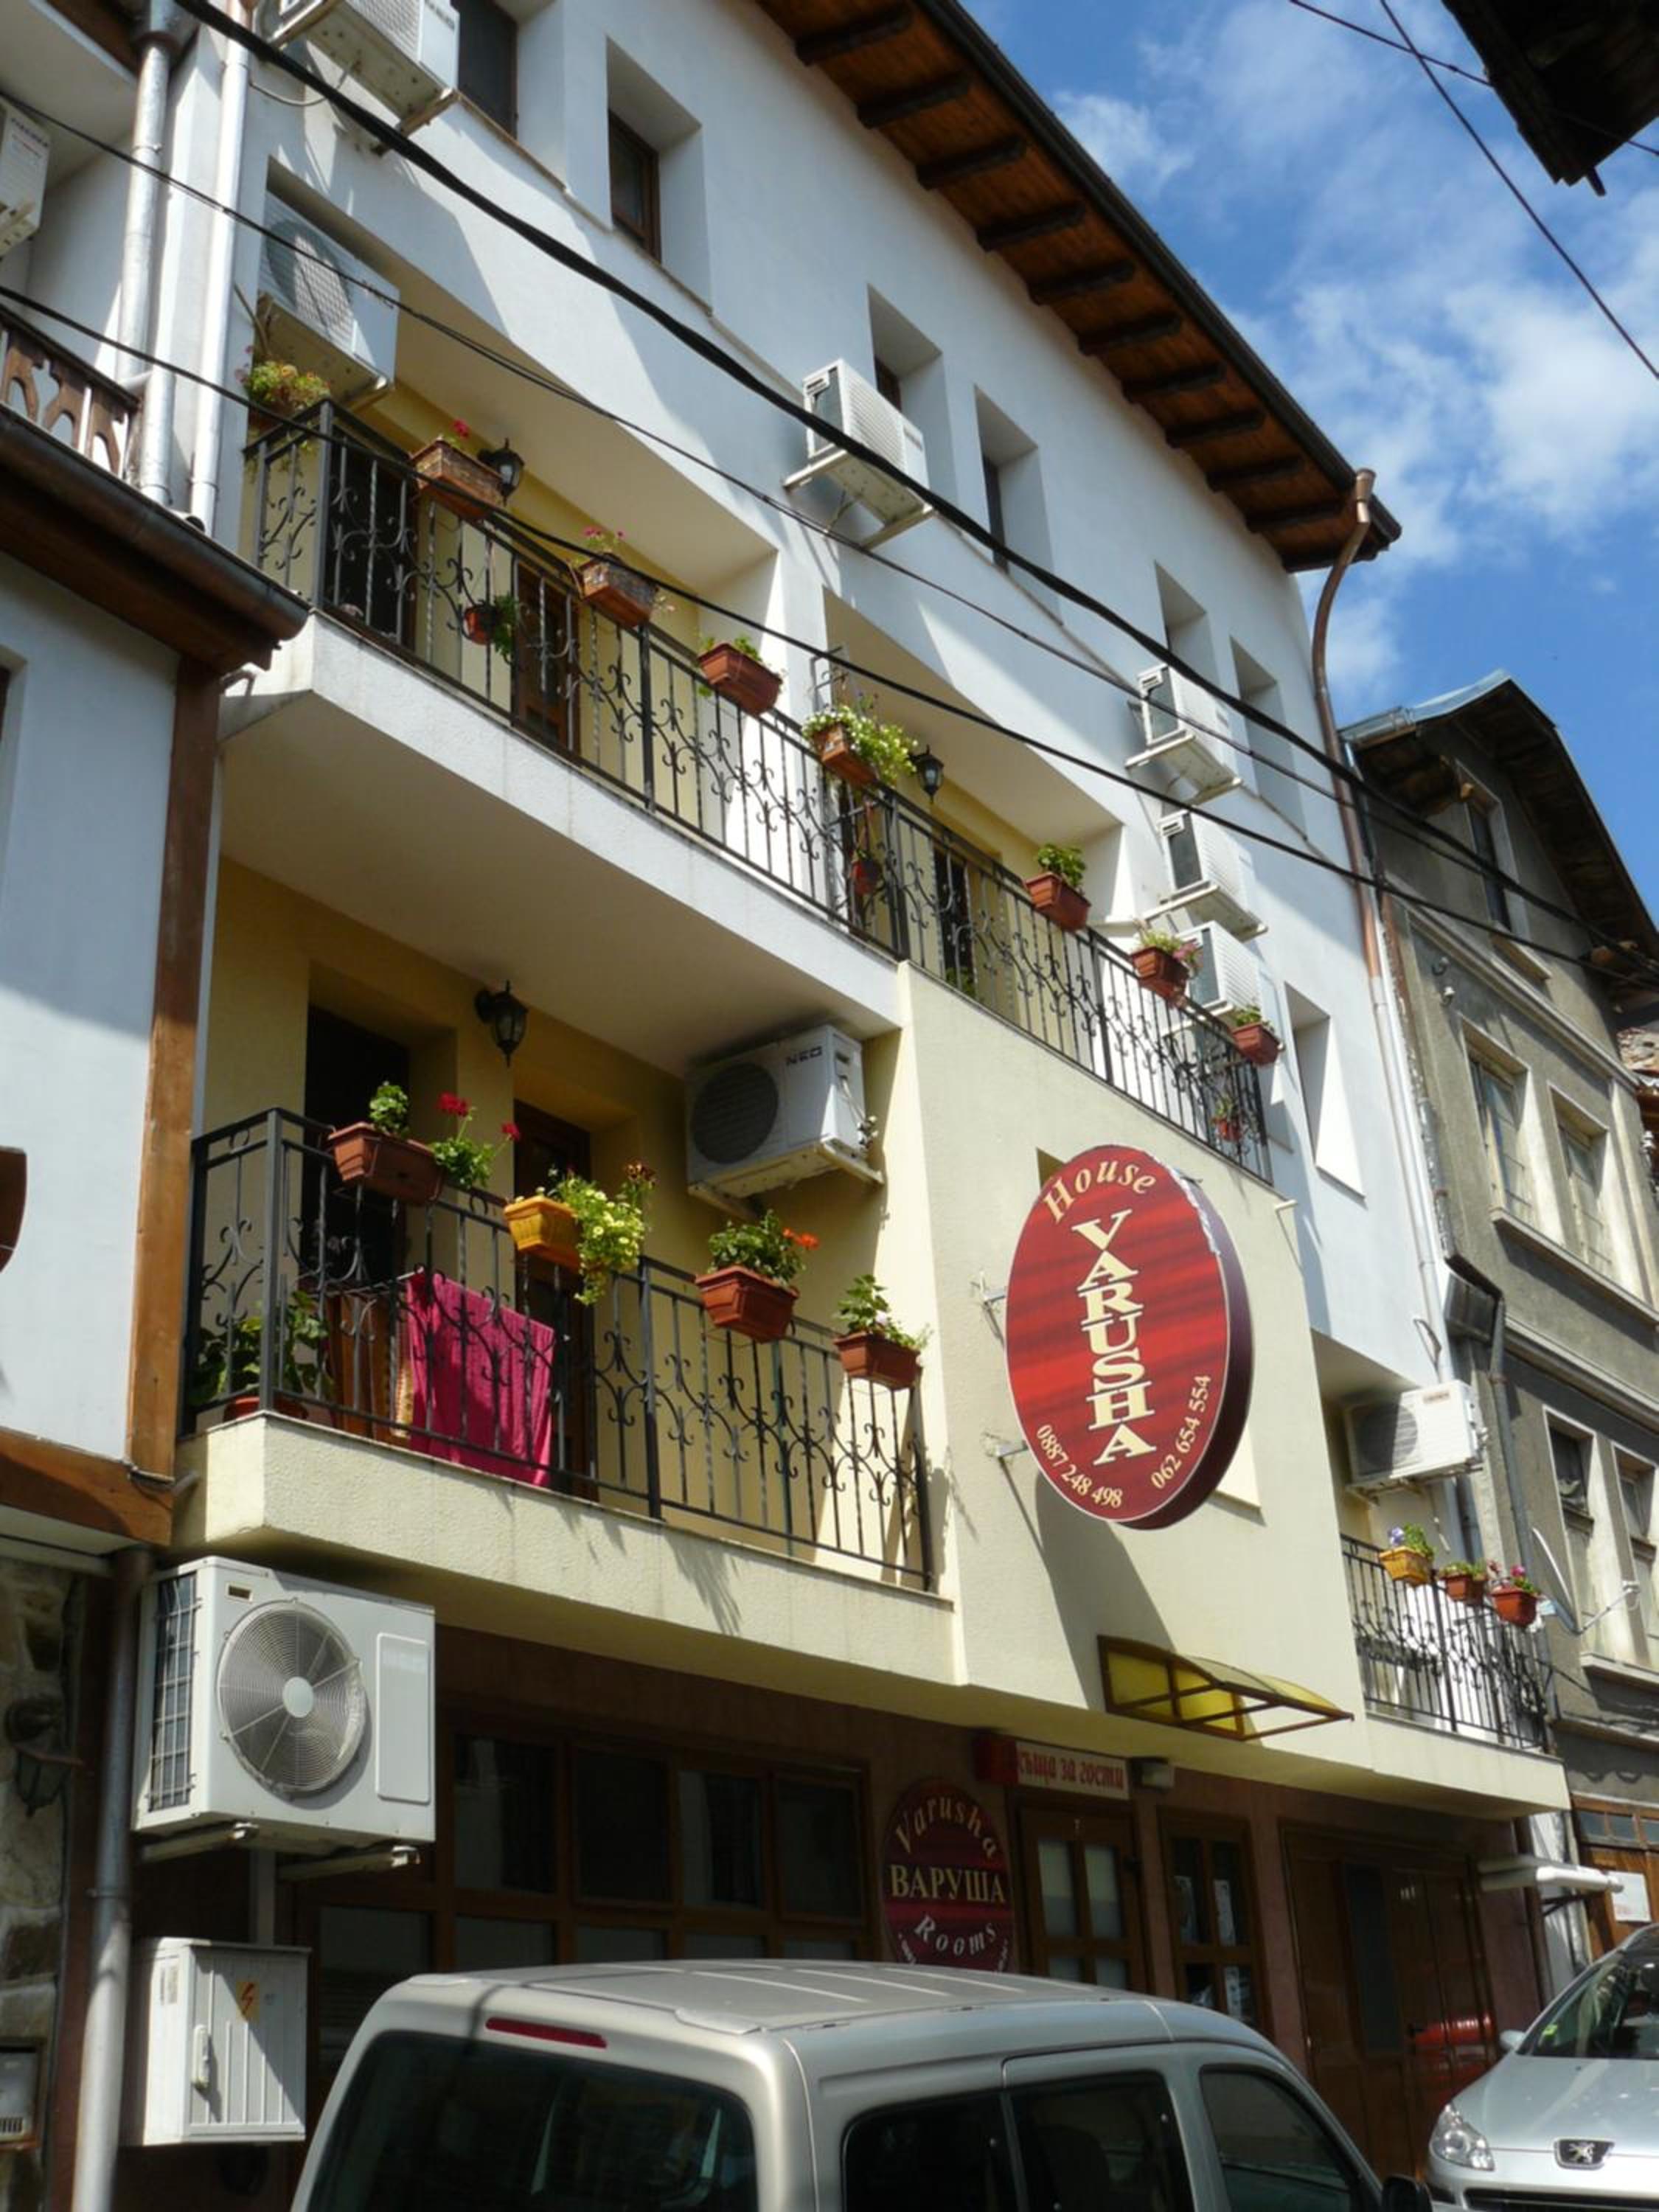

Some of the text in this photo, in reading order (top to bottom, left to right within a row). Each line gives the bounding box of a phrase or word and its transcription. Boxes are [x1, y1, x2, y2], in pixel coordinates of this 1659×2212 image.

[1043, 1161, 1157, 1224] House
[1071, 1208, 1157, 1466] VARUSHA
[1151, 1375, 1211, 1489] 062 654 554
[1037, 1425, 1123, 1508] 0887 248 498
[896, 1796, 998, 1859] Varusha
[890, 1864, 1006, 1904] ВАРУША
[914, 1913, 997, 1956] Rooms
